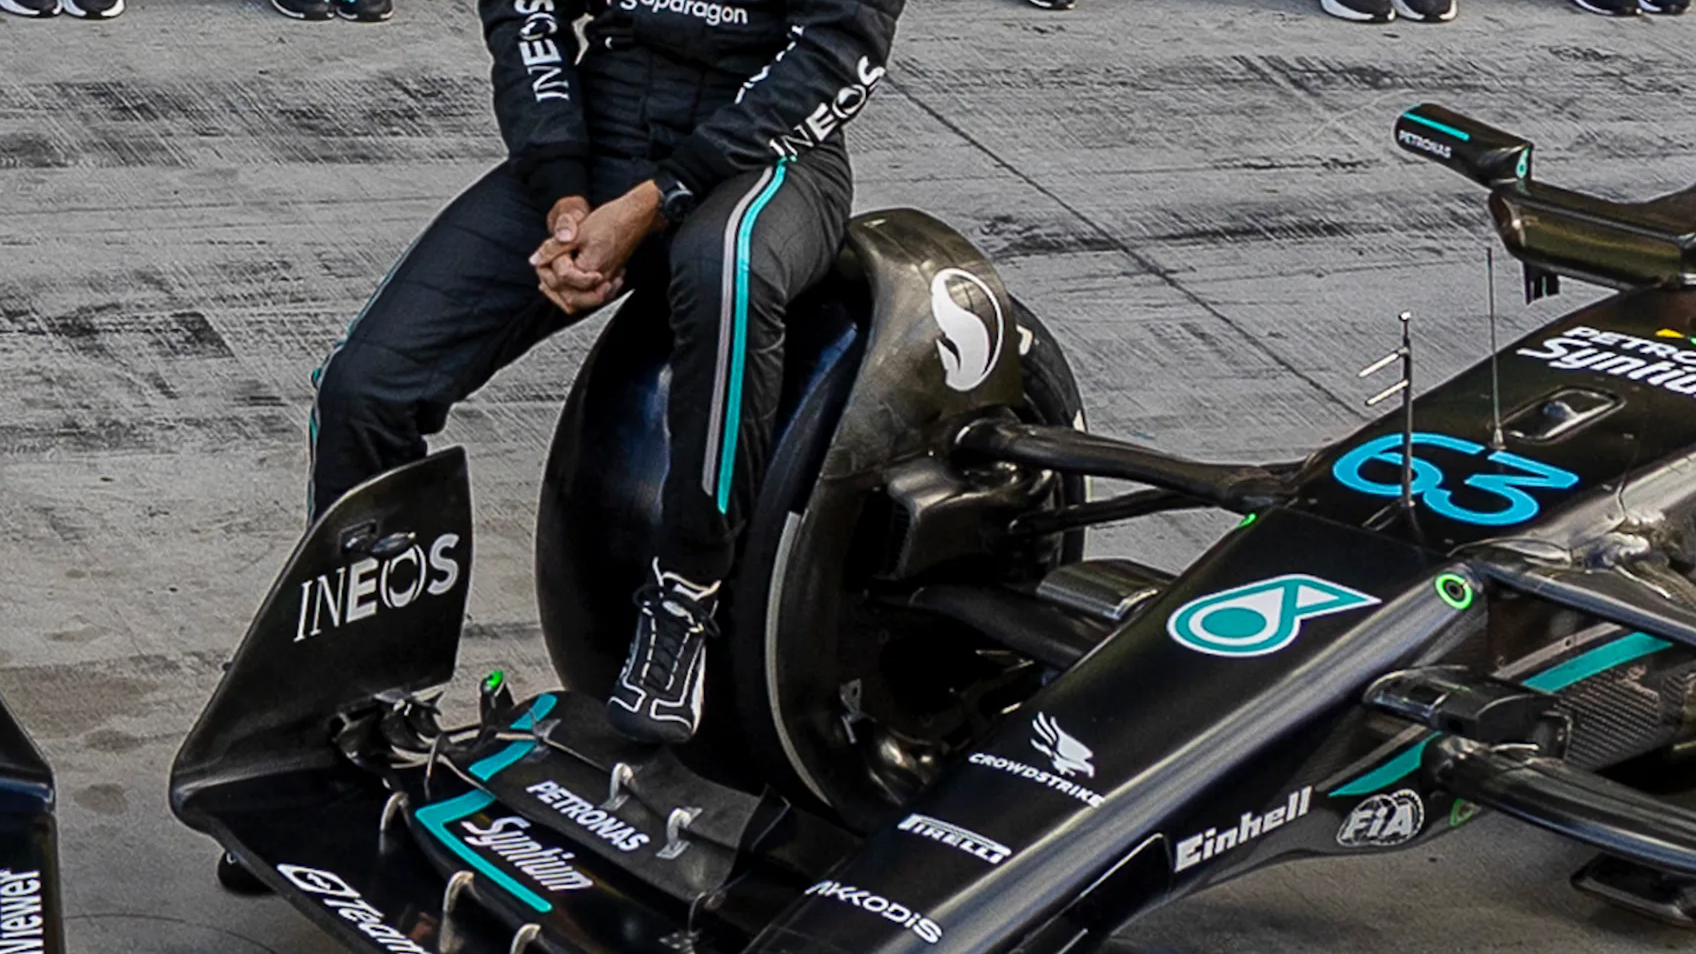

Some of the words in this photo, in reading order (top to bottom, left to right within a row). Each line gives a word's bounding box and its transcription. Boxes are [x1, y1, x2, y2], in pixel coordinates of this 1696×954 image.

[769, 55, 886, 162] INEOS
[1332, 432, 1580, 526] 63
[293, 533, 460, 642] INEOS
[526, 780, 651, 851] PETRONAS
[968, 752, 1105, 808] CROWDSTRIKE
[460, 816, 593, 891] Syntium
[897, 813, 1012, 864] PIRELLI
[1174, 786, 1312, 872] Einhell
